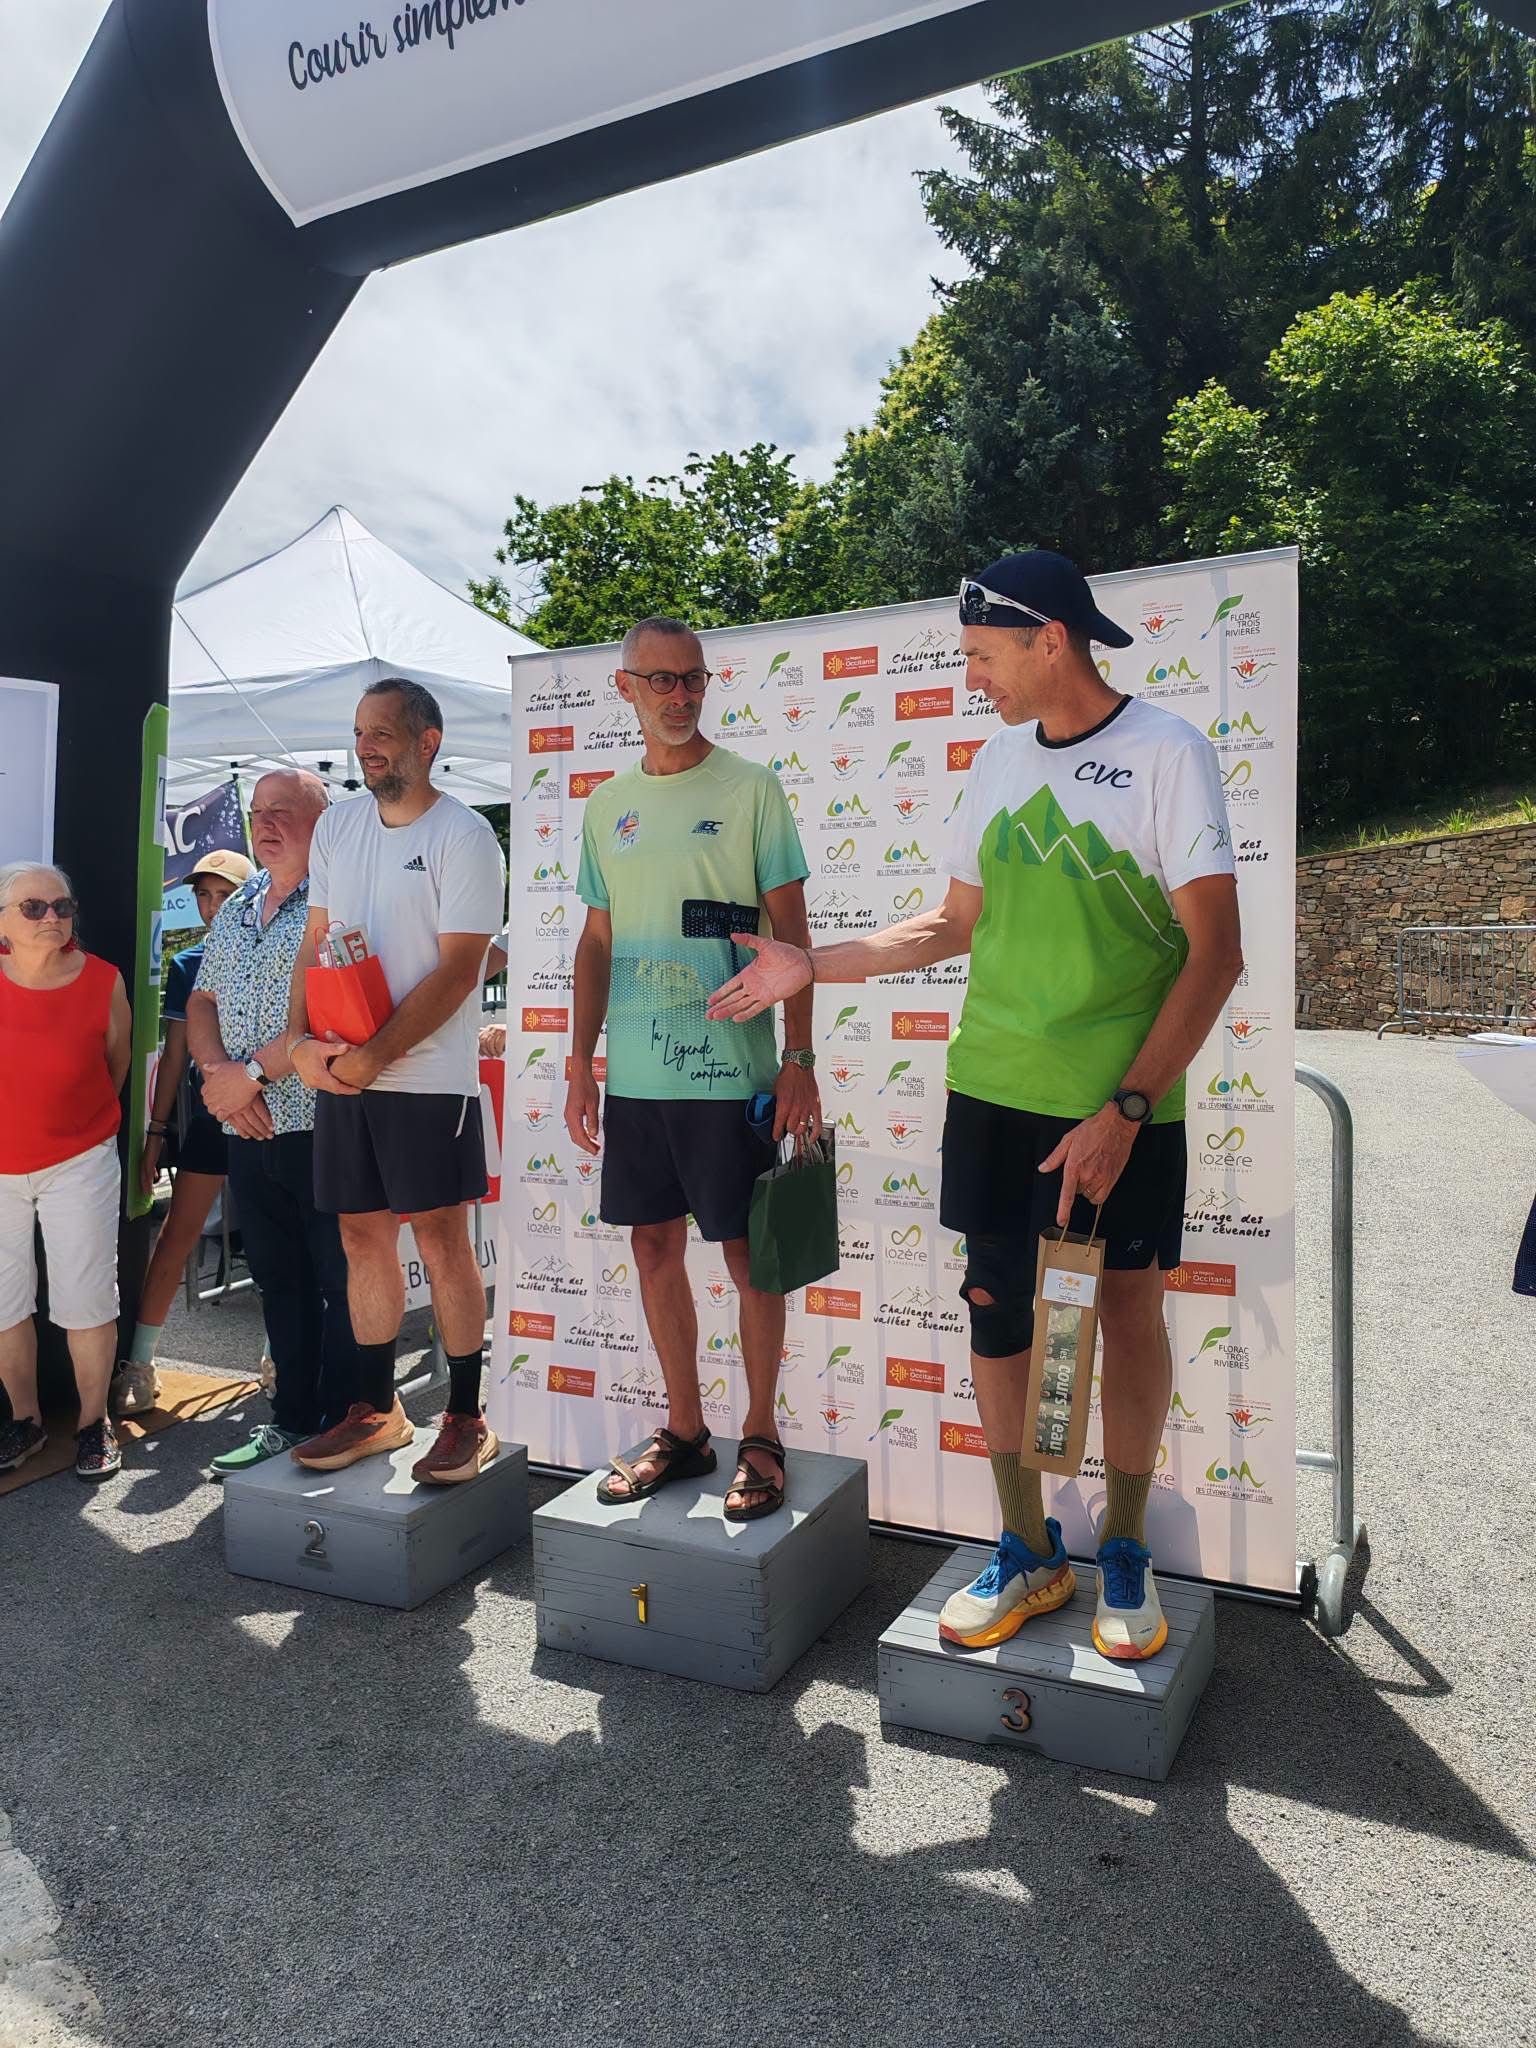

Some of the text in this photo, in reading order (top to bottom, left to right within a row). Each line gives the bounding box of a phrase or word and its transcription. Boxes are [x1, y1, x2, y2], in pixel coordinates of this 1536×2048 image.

[288, 22, 387, 91] Courir
[1231, 611, 1260, 622] FLORAC
[1237, 620, 1260, 628] TROIS
[892, 650, 945, 664] Challenge
[781, 666, 803, 675] FLORAC
[887, 658, 967, 675] vallées cévenol
[530, 689, 591, 703] Challenge des
[526, 700, 595, 712] vallées cévenoles
[851, 706, 875, 714] FLORAC
[588, 729, 632, 741] Challenge
[584, 737, 645, 750] vallées céveno
[901, 756, 925, 764] FLORAC
[1074, 761, 1133, 788] CVC
[1224, 788, 1260, 802] zère
[1240, 838, 1262, 849] des
[821, 863, 860, 875] lozère
[808, 909, 872, 920] hallenge des
[809, 919, 878, 930] llées cévenoles
[532, 971, 574, 983] Challeng
[664, 1034, 714, 1072] Légende
[690, 1059, 740, 1092] continue
[1200, 1152, 1252, 1167] lozère
[1183, 1213, 1263, 1225] allenge des
[1213, 1223, 1270, 1238] cévenoles
[852, 1240, 869, 1249] des
[885, 1248, 927, 1262] lozère
[1193, 1275, 1232, 1284] Occitanie
[597, 1285, 632, 1298] lozère
[880, 1303, 958, 1321] Challenge des
[873, 1315, 964, 1333] vallées cévenoles
[1219, 1345, 1249, 1355] FLORAC
[1226, 1353, 1249, 1362] TROIS
[910, 1372, 942, 1382] Occitanie
[1054, 1364, 1072, 1405] cours
[954, 1391, 976, 1401] vall
[641, 1397, 669, 1410] céveno
[704, 1401, 731, 1414] zère
[893, 1425, 917, 1435] FLORAC
[899, 1433, 917, 1442] TROIS
[965, 1436, 987, 1446] Occita
[304, 1520, 327, 1558] 2
[1000, 1687, 1032, 1733] 3
